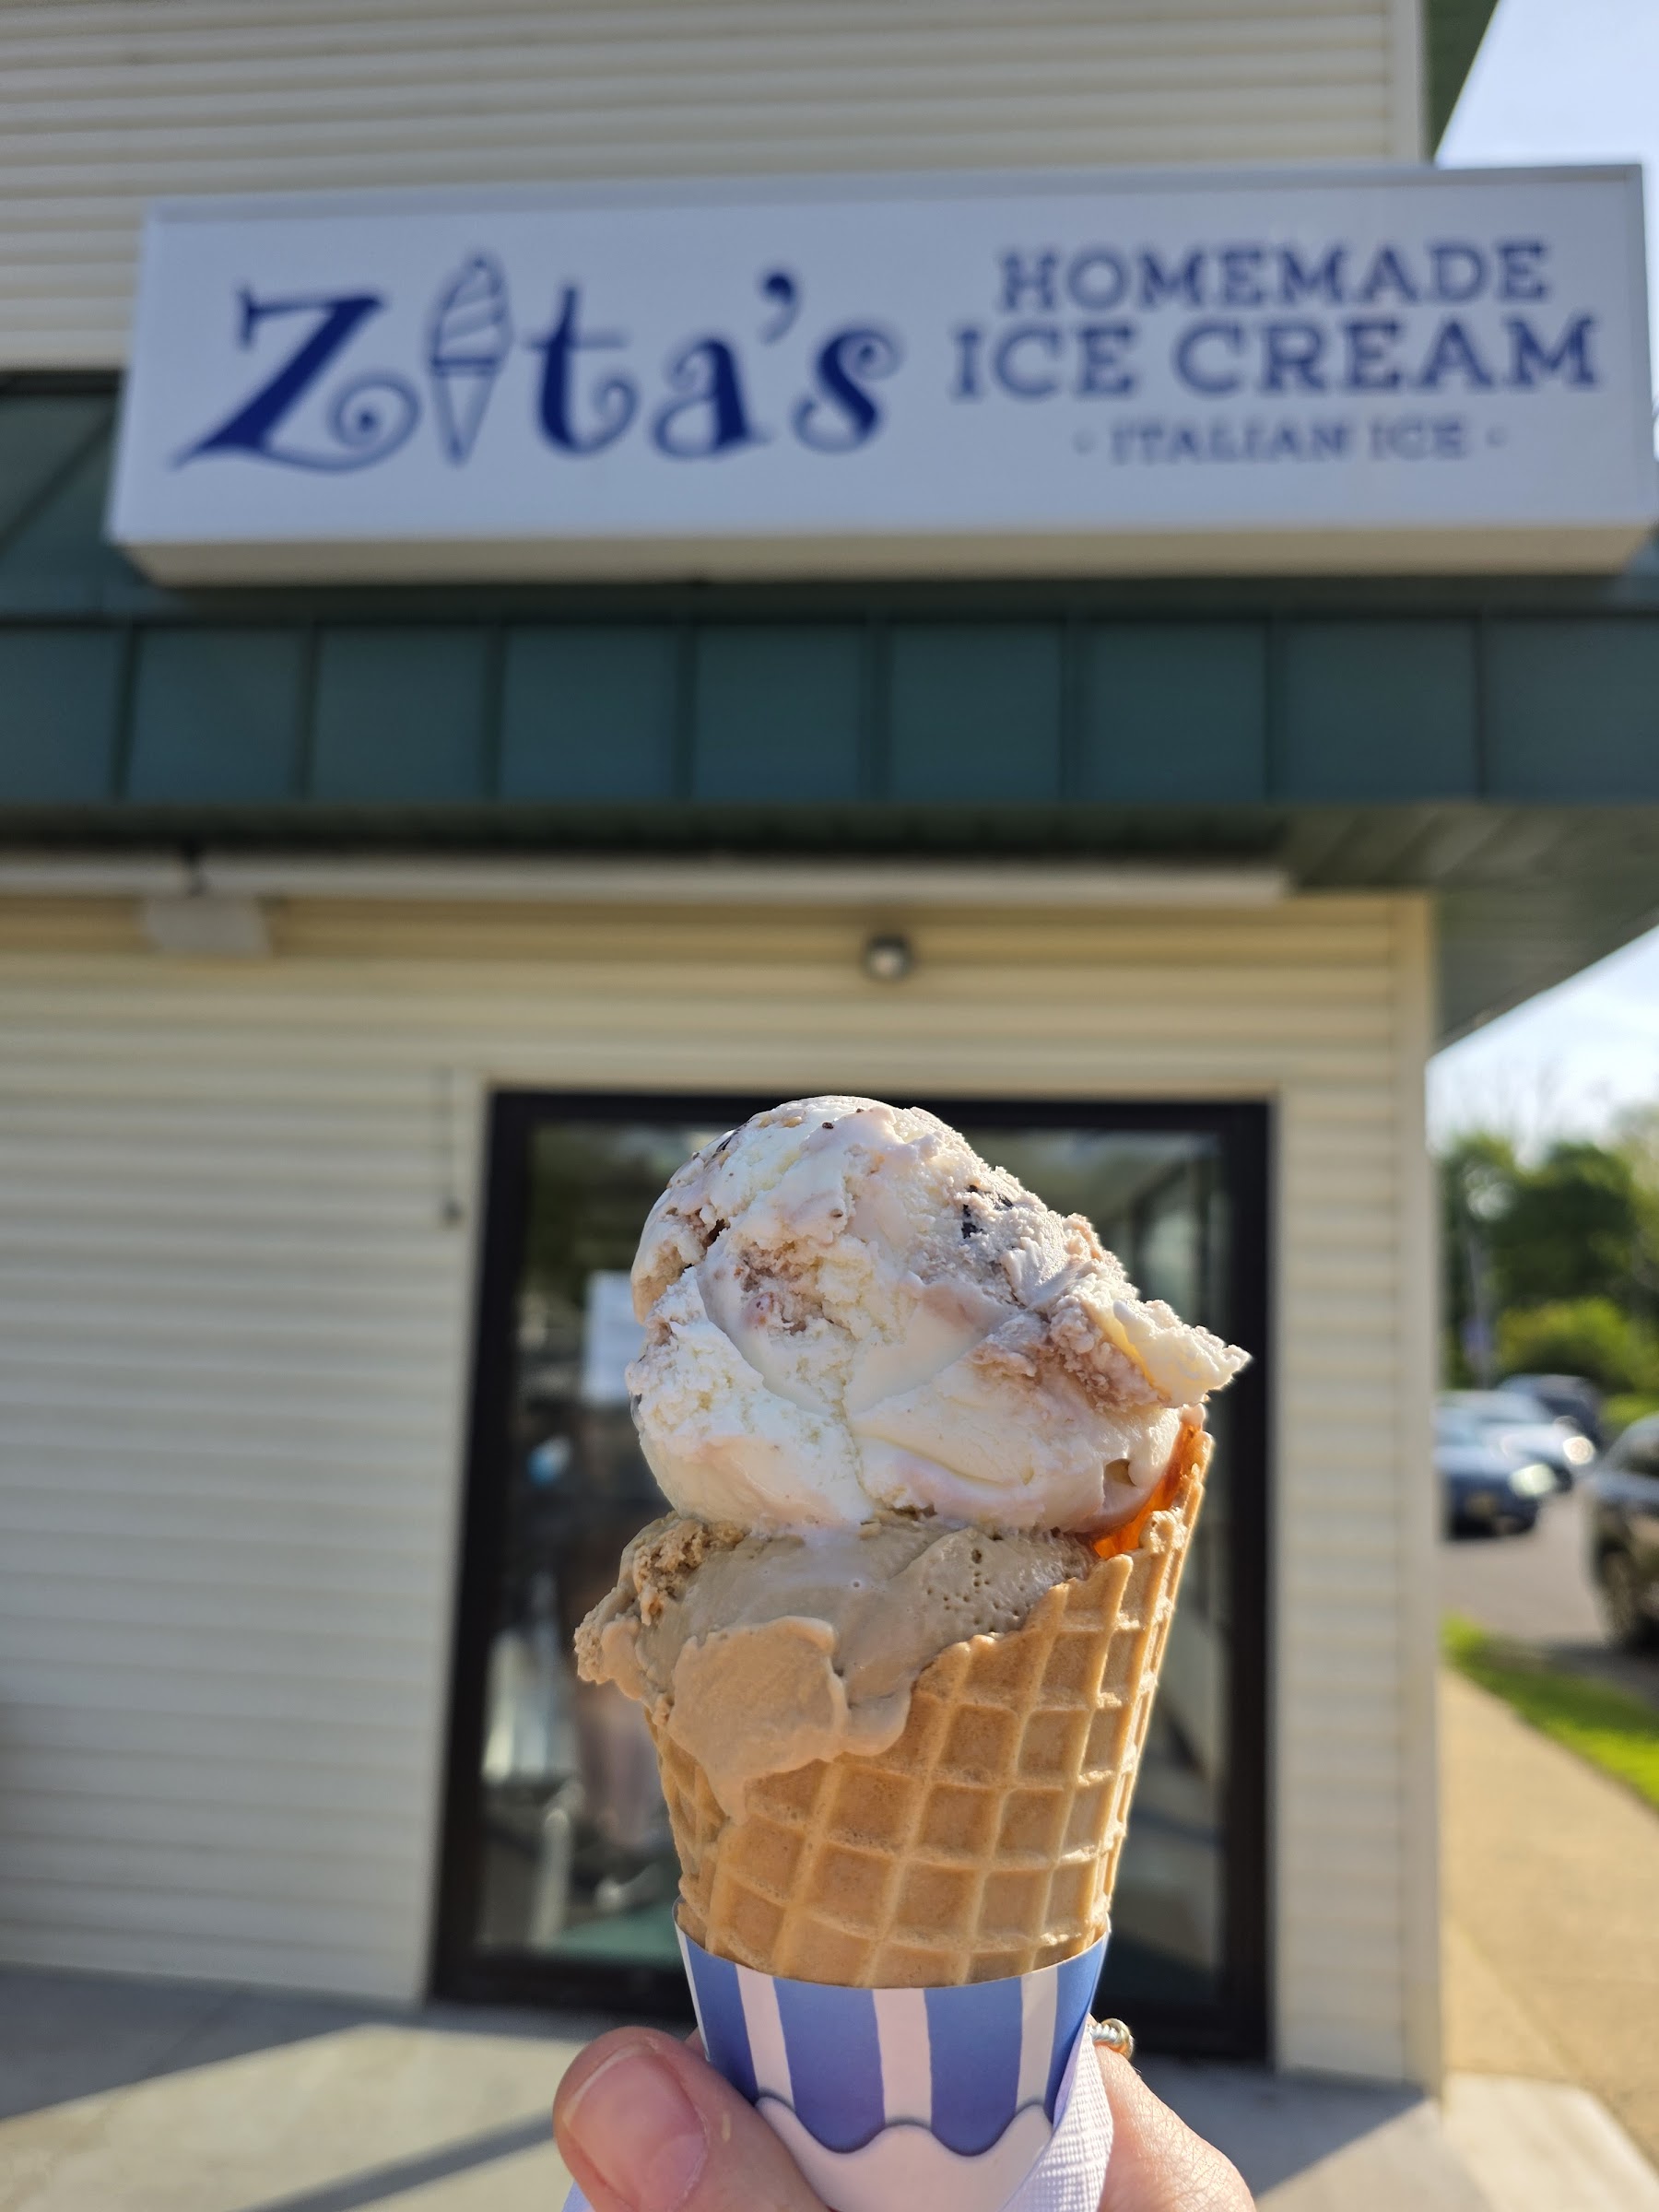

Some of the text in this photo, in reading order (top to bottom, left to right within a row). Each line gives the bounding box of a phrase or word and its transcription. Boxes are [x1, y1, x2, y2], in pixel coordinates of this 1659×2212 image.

[999, 240, 1552, 312] HOMEMADE
[951, 312, 1599, 402] ICE CREAM
[1112, 414, 1467, 463] ITALIAN ICE
